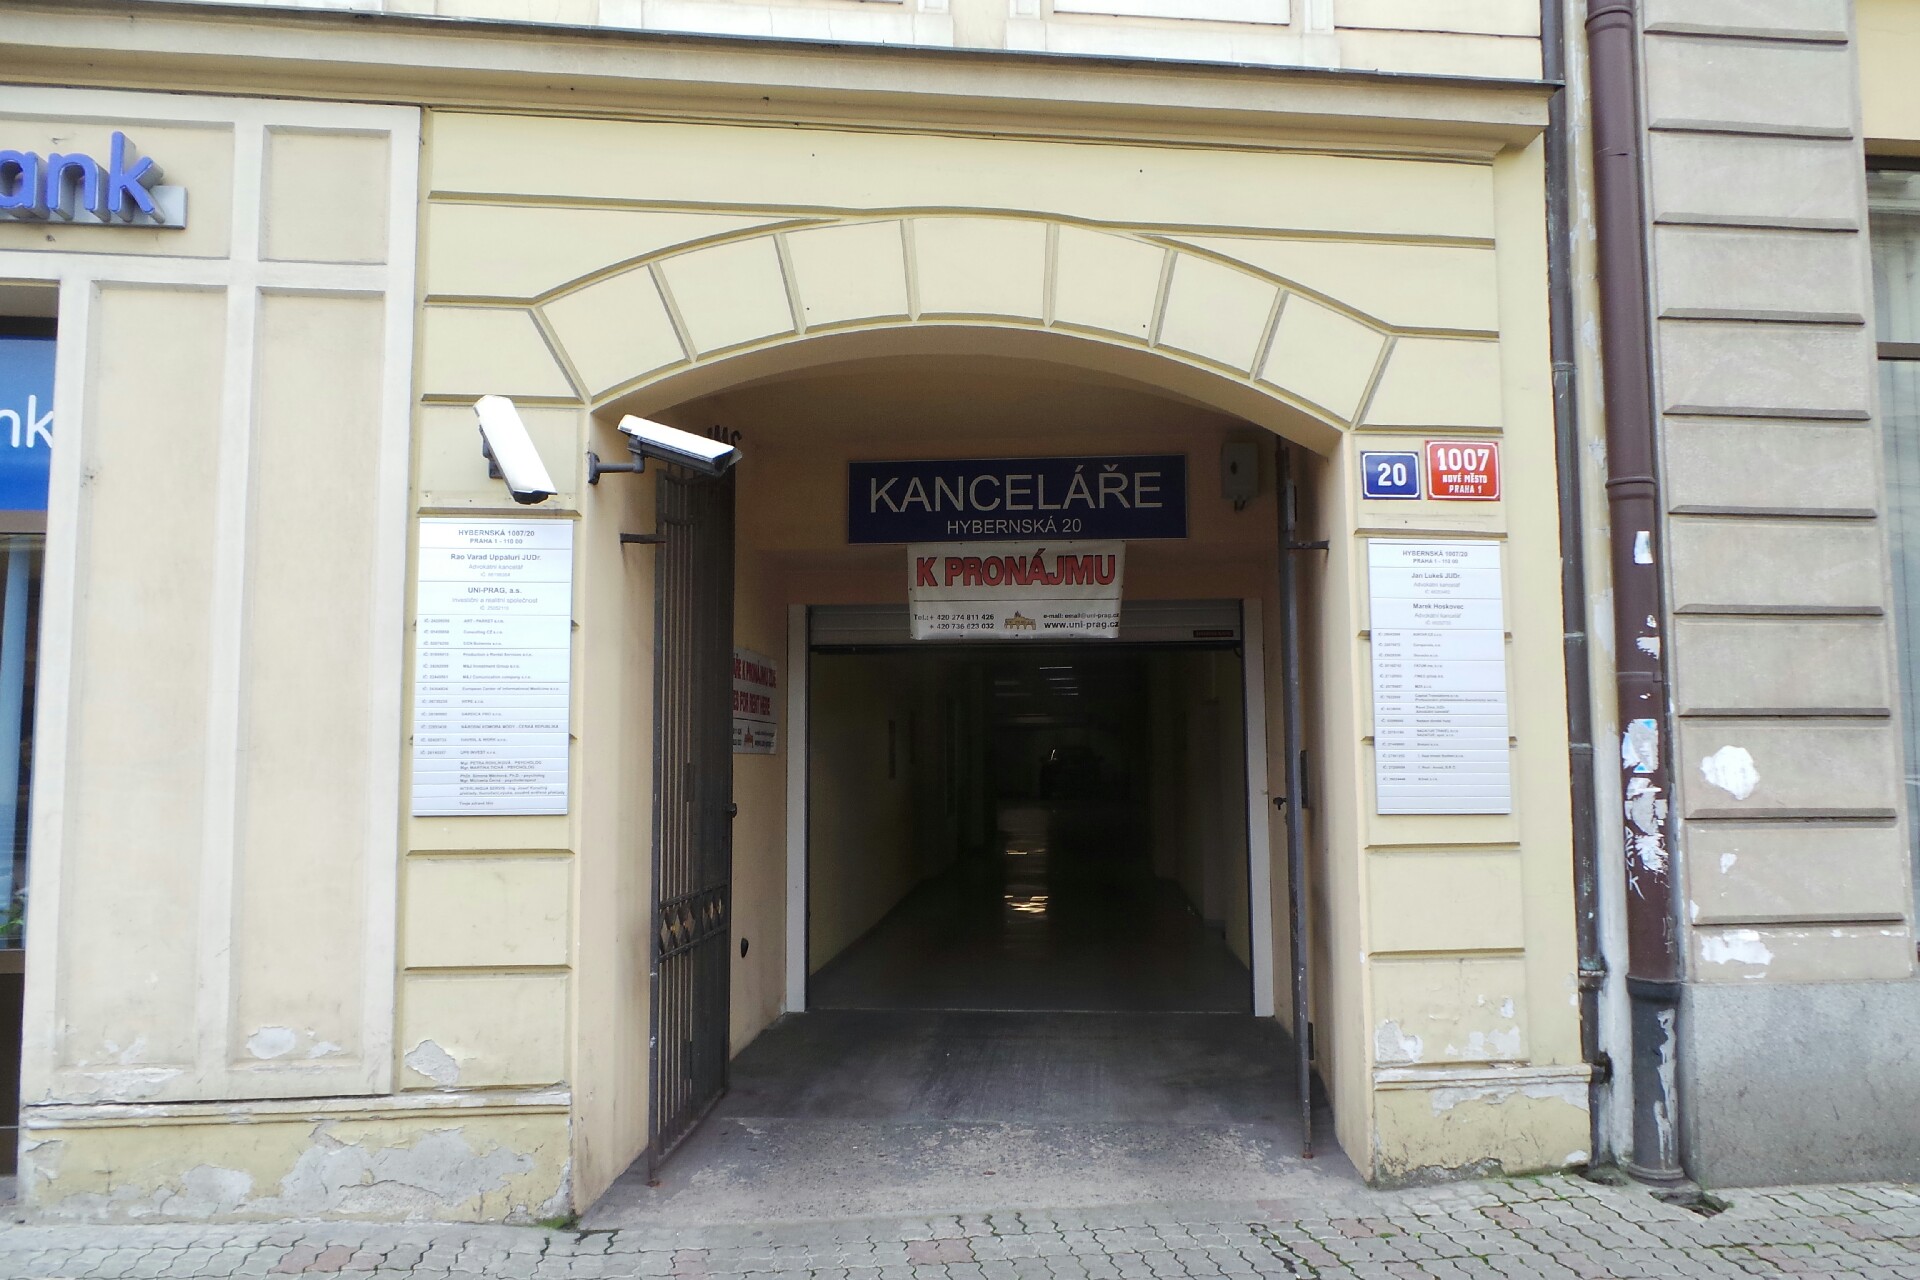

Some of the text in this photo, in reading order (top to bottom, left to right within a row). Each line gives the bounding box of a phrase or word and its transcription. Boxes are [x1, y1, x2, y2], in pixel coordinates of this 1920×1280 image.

[1437, 447, 1490, 472] 1007
[1377, 462, 1407, 487] 20
[1442, 472, 1488, 484] NOVÉ MĚSTO
[868, 464, 1164, 515] KANCELÁŘE
[1449, 485, 1482, 494] PRAHA 1
[946, 514, 1083, 536] HYBERNSKÁ 20
[916, 548, 1116, 587] K PRONÁJMU
[936, 613, 950, 621] 420
[952, 613, 965, 621] 274
[966, 613, 979, 621] 811
[981, 613, 995, 621] 426
[1044, 621, 1120, 630] www.uni-prag.cz
